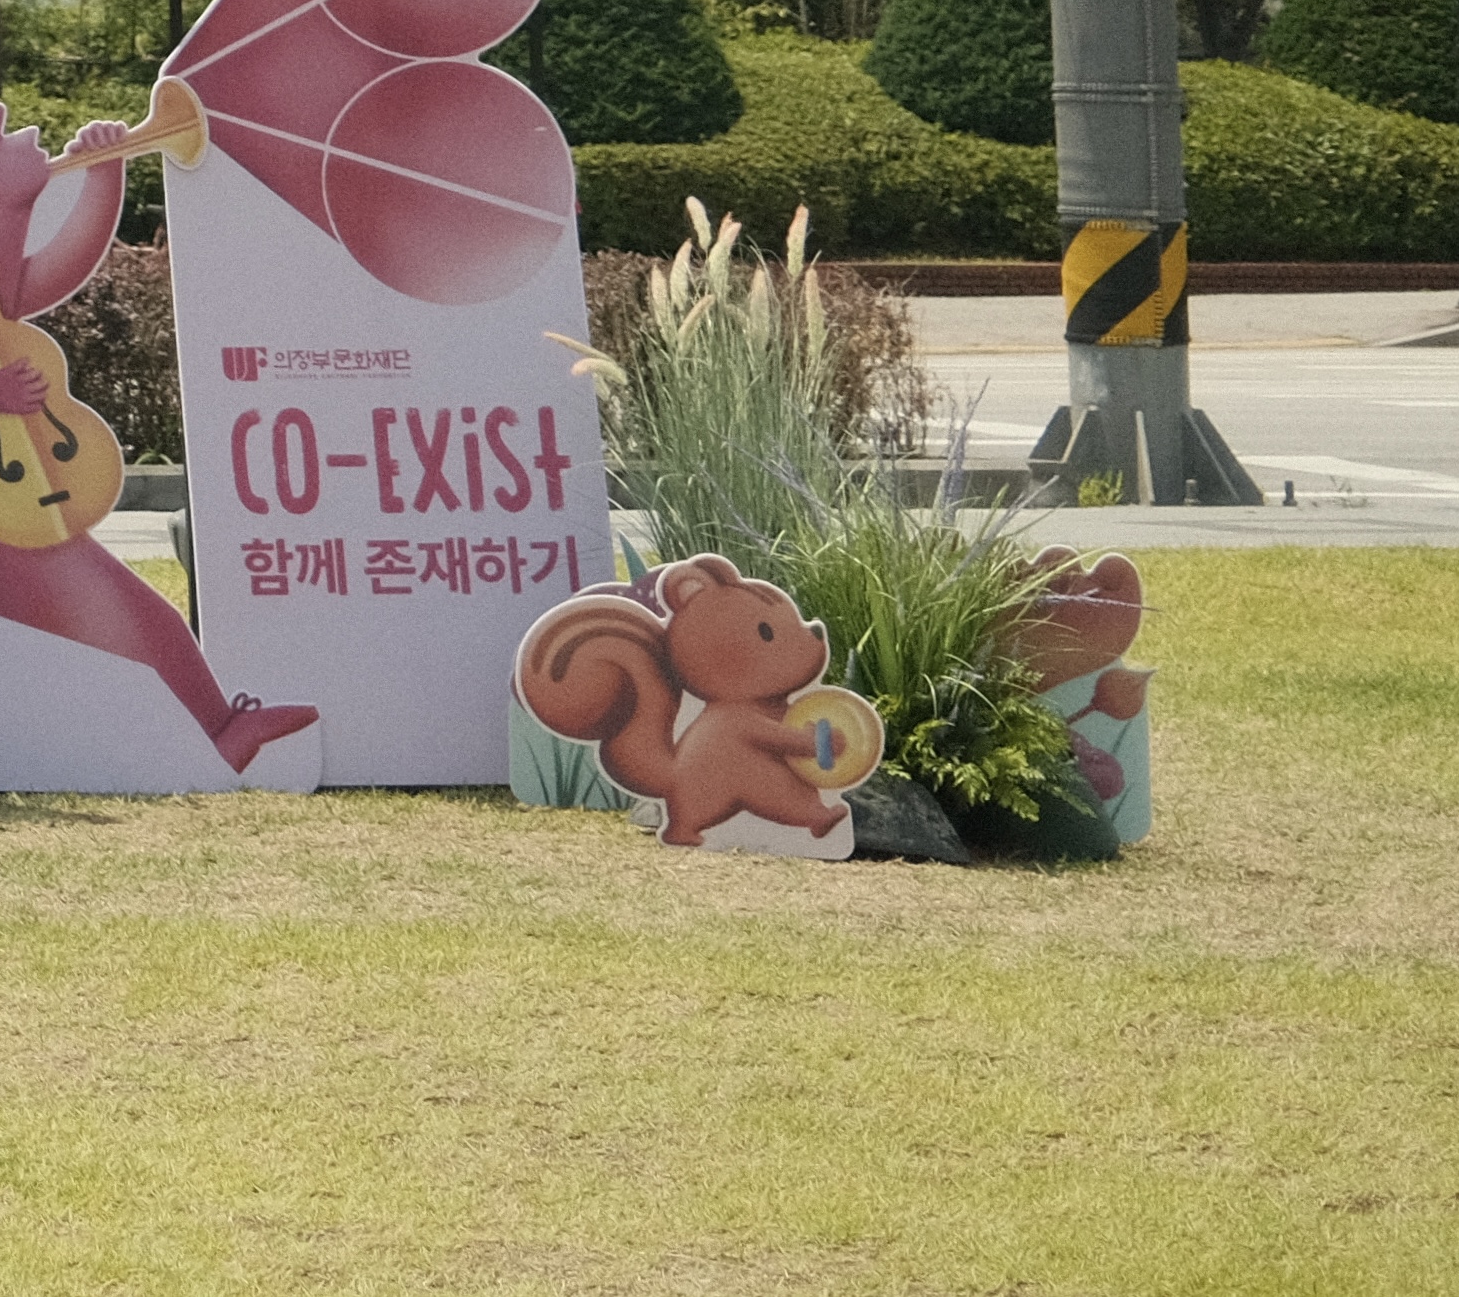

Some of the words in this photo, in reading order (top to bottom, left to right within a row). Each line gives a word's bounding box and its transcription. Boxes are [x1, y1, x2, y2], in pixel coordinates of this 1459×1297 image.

[274, 349, 412, 371] 의정부문화재단
[240, 535, 349, 596] 함께
[363, 534, 581, 595] 존재하기
